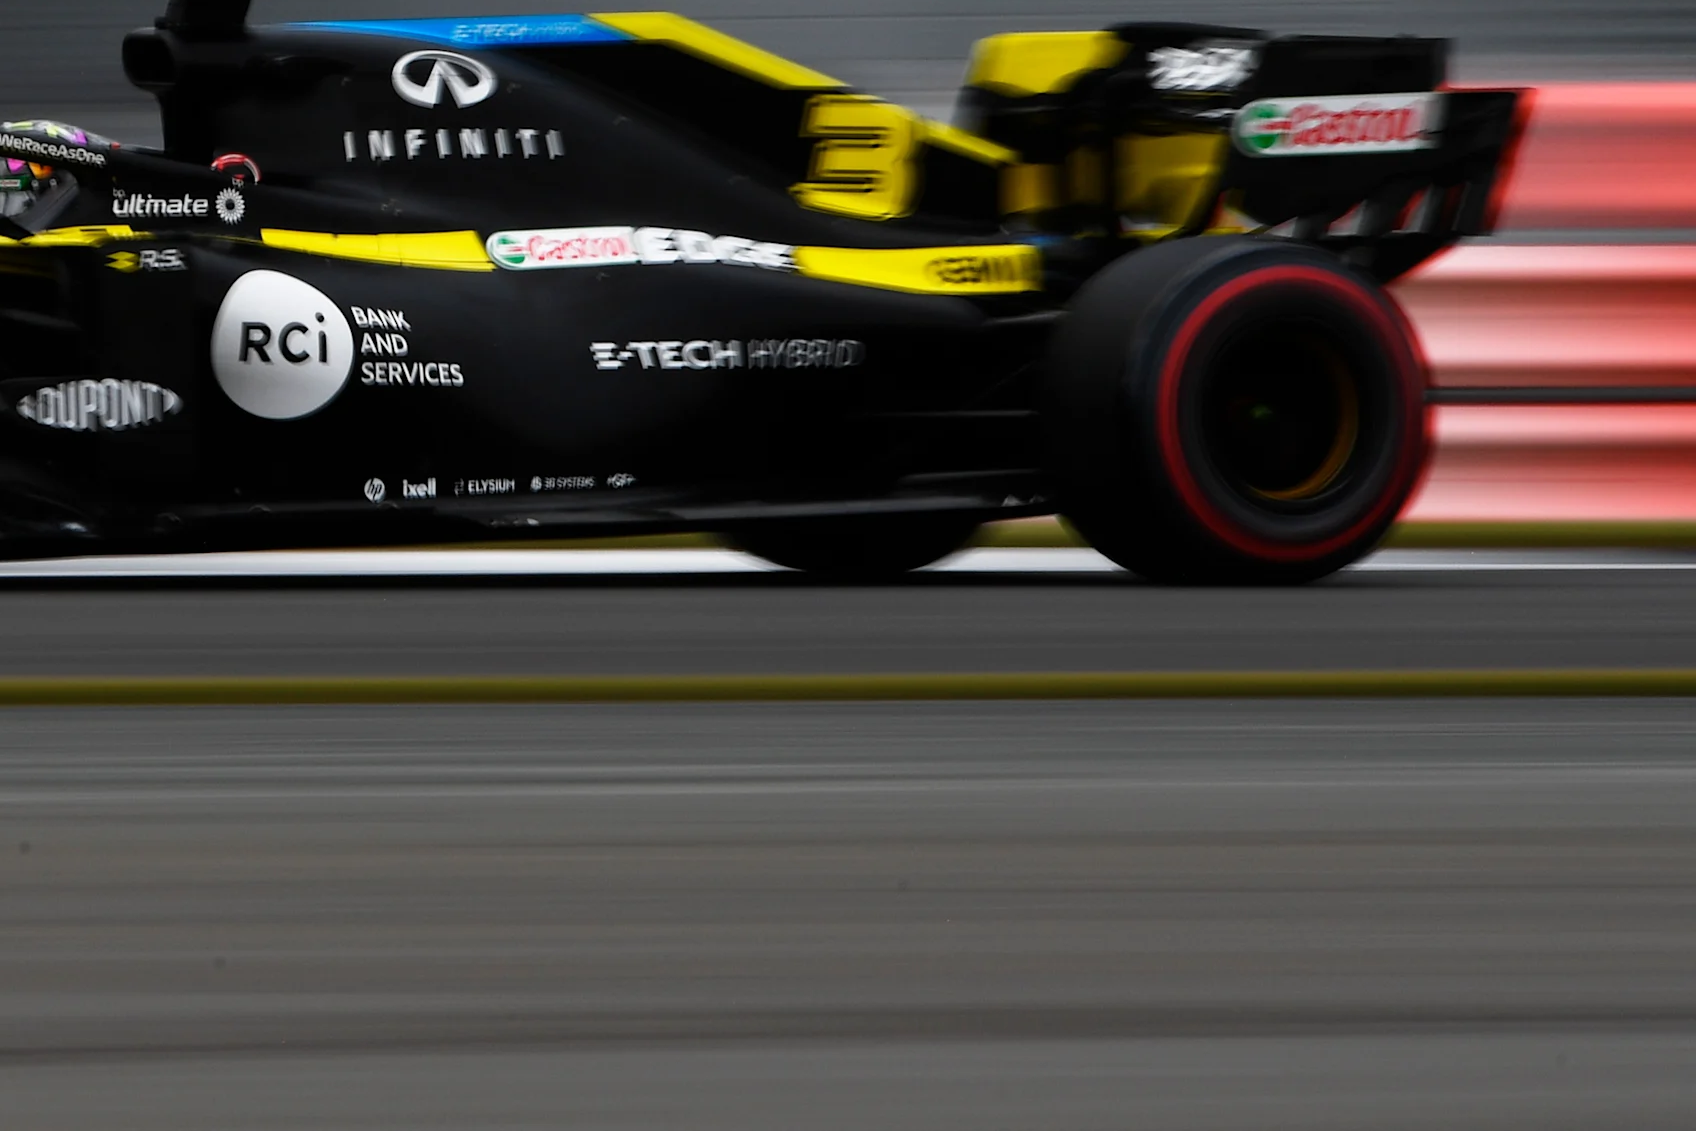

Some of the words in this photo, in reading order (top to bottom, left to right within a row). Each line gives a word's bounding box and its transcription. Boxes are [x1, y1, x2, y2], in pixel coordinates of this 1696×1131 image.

[343, 128, 565, 162] INFINITI
[789, 93, 926, 222] 3
[112, 193, 208, 218] ultimate
[350, 306, 412, 332] BANK
[360, 333, 408, 356] AND
[590, 340, 743, 370] E-TECH
[360, 362, 464, 387] SERVICES
[35, 378, 164, 432] DUPONT
[468, 478, 516, 495] ELYSIUM
